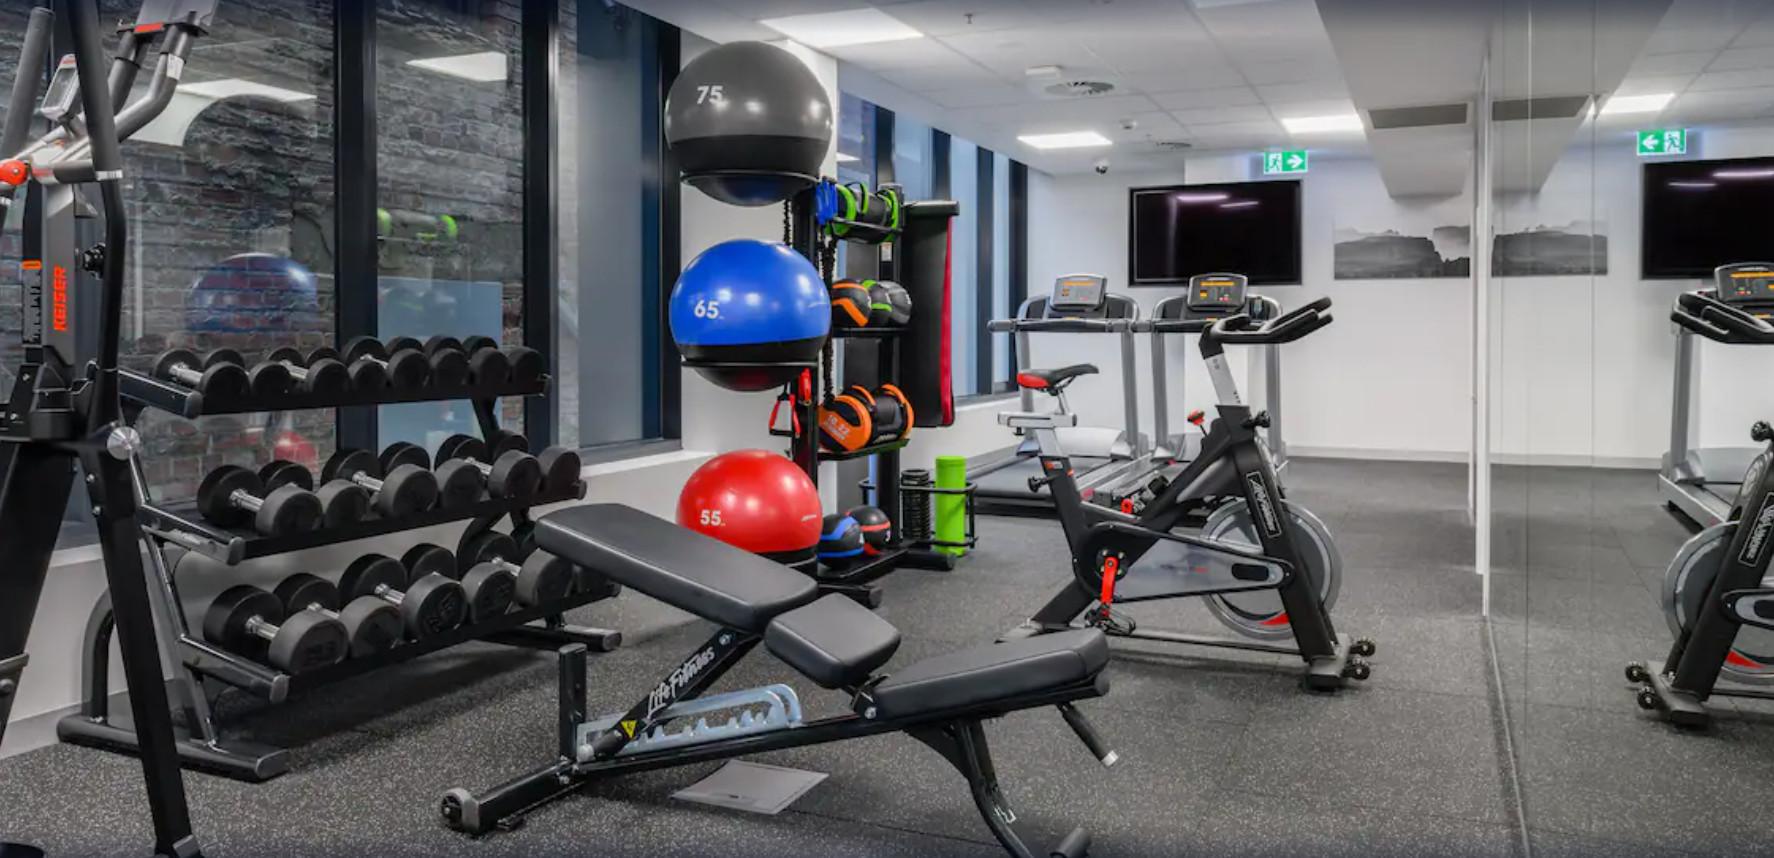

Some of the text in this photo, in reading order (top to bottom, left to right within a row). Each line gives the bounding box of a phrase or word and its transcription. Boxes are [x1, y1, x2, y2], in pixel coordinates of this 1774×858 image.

[697, 85, 724, 104] 75
[53, 264, 68, 331] KEISER
[694, 299, 720, 319] 65
[700, 509, 721, 526] 55
[646, 646, 715, 720] Life Fitness
